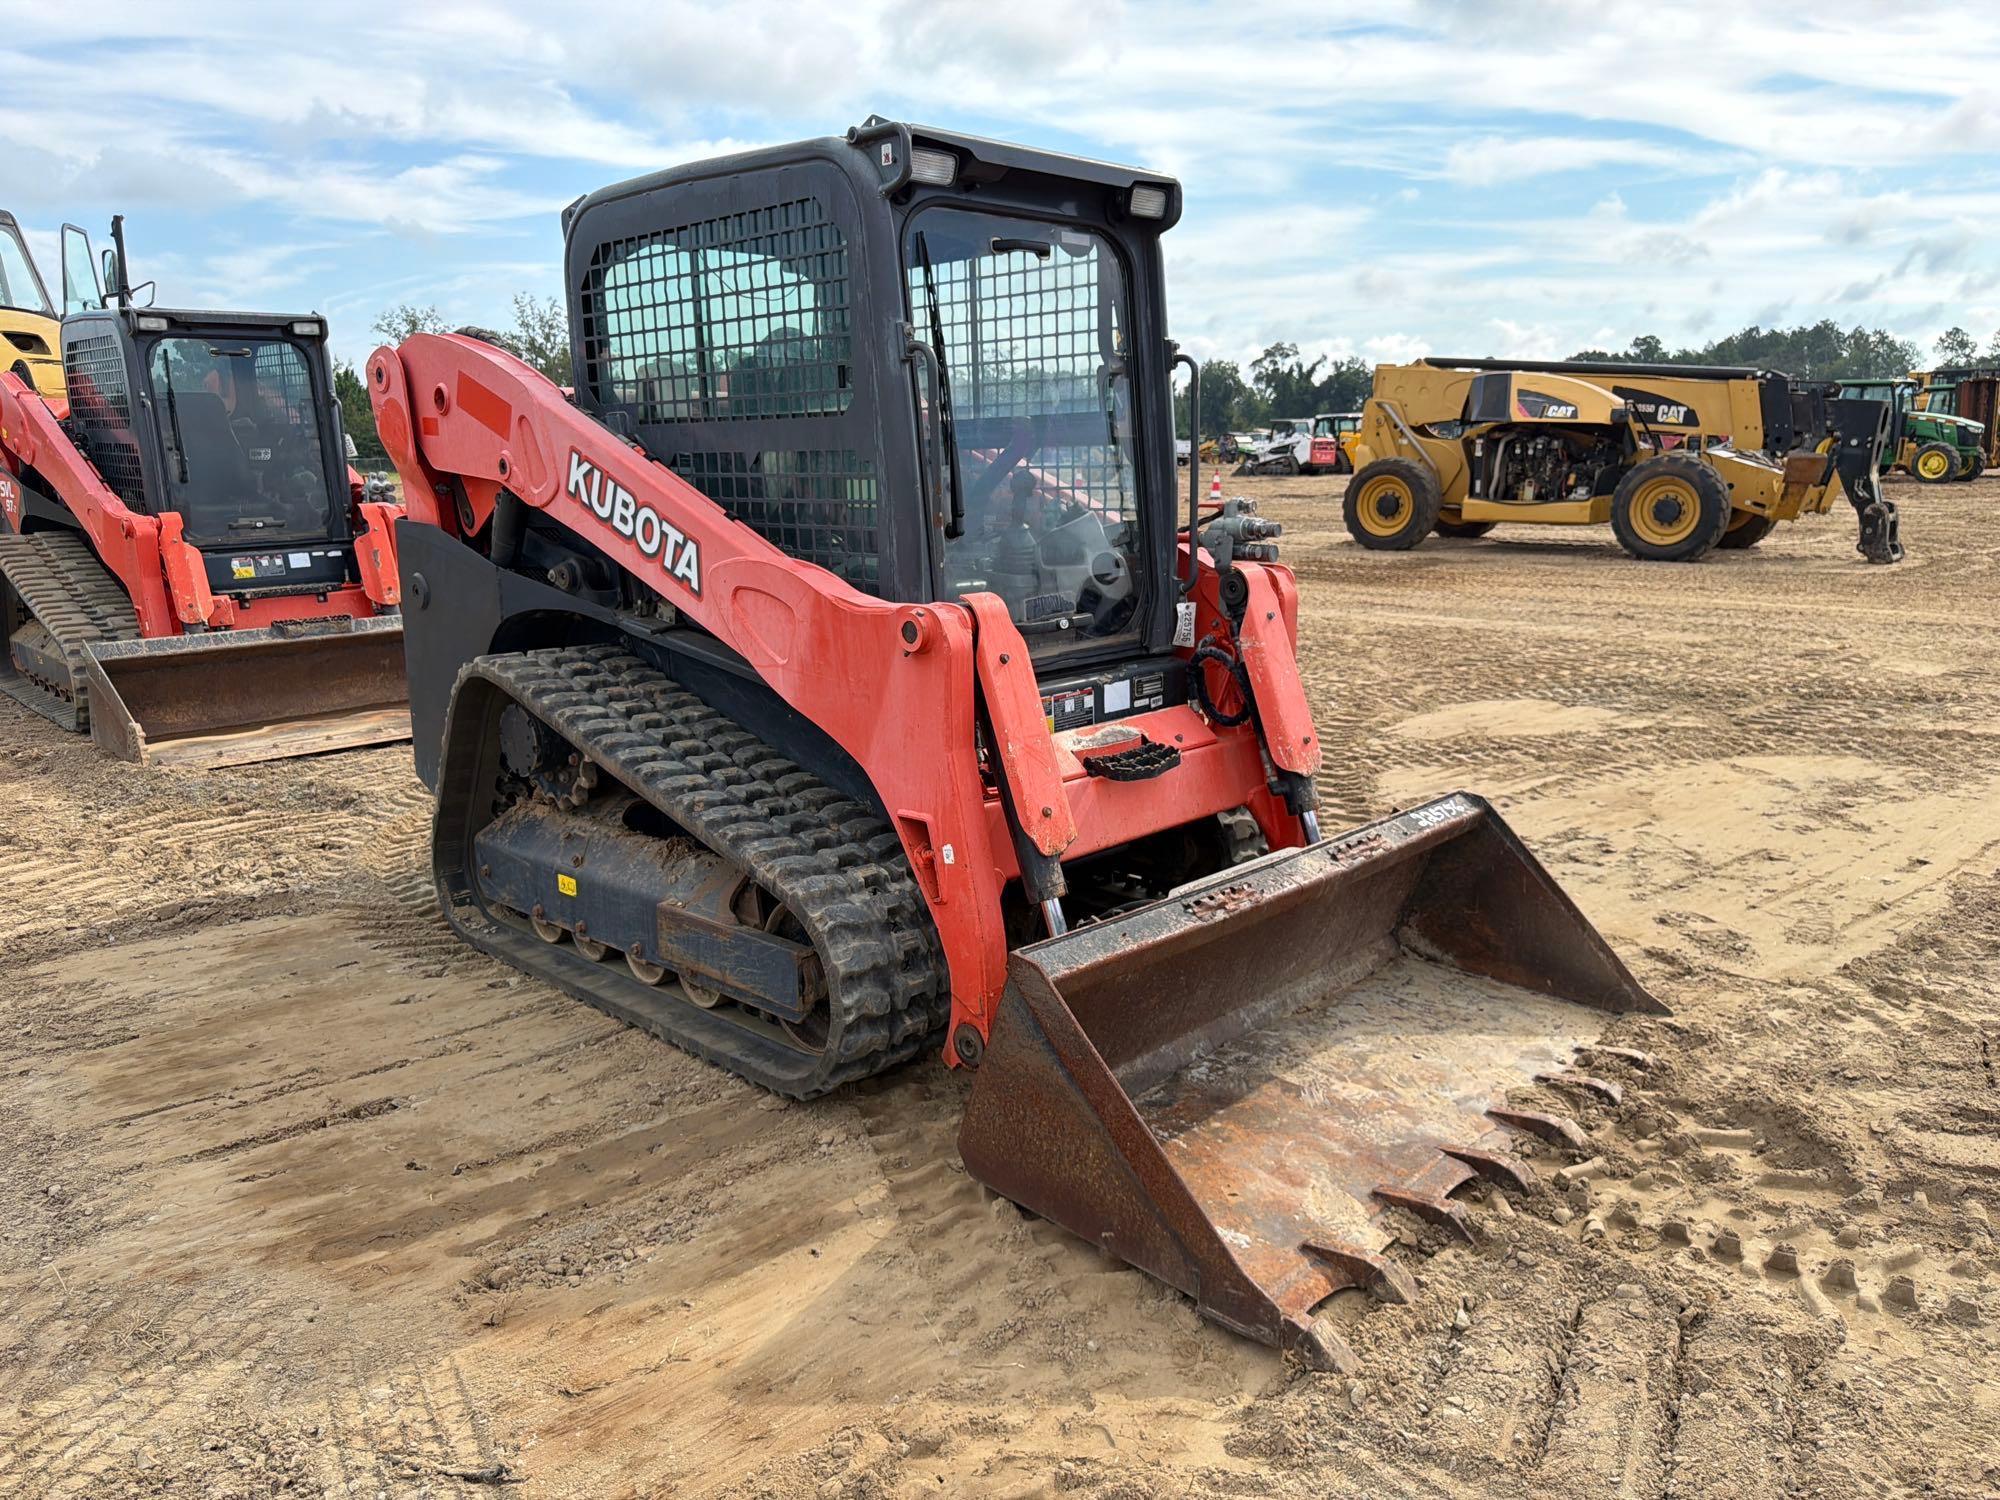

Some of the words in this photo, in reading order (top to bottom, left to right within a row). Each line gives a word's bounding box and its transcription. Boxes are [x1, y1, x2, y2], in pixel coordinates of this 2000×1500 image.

[1547, 405, 1576, 418] CAT
[1656, 404, 1688, 423] CAT
[567, 451, 699, 592] KUBOTA
[1181, 611, 1193, 642] 225756
